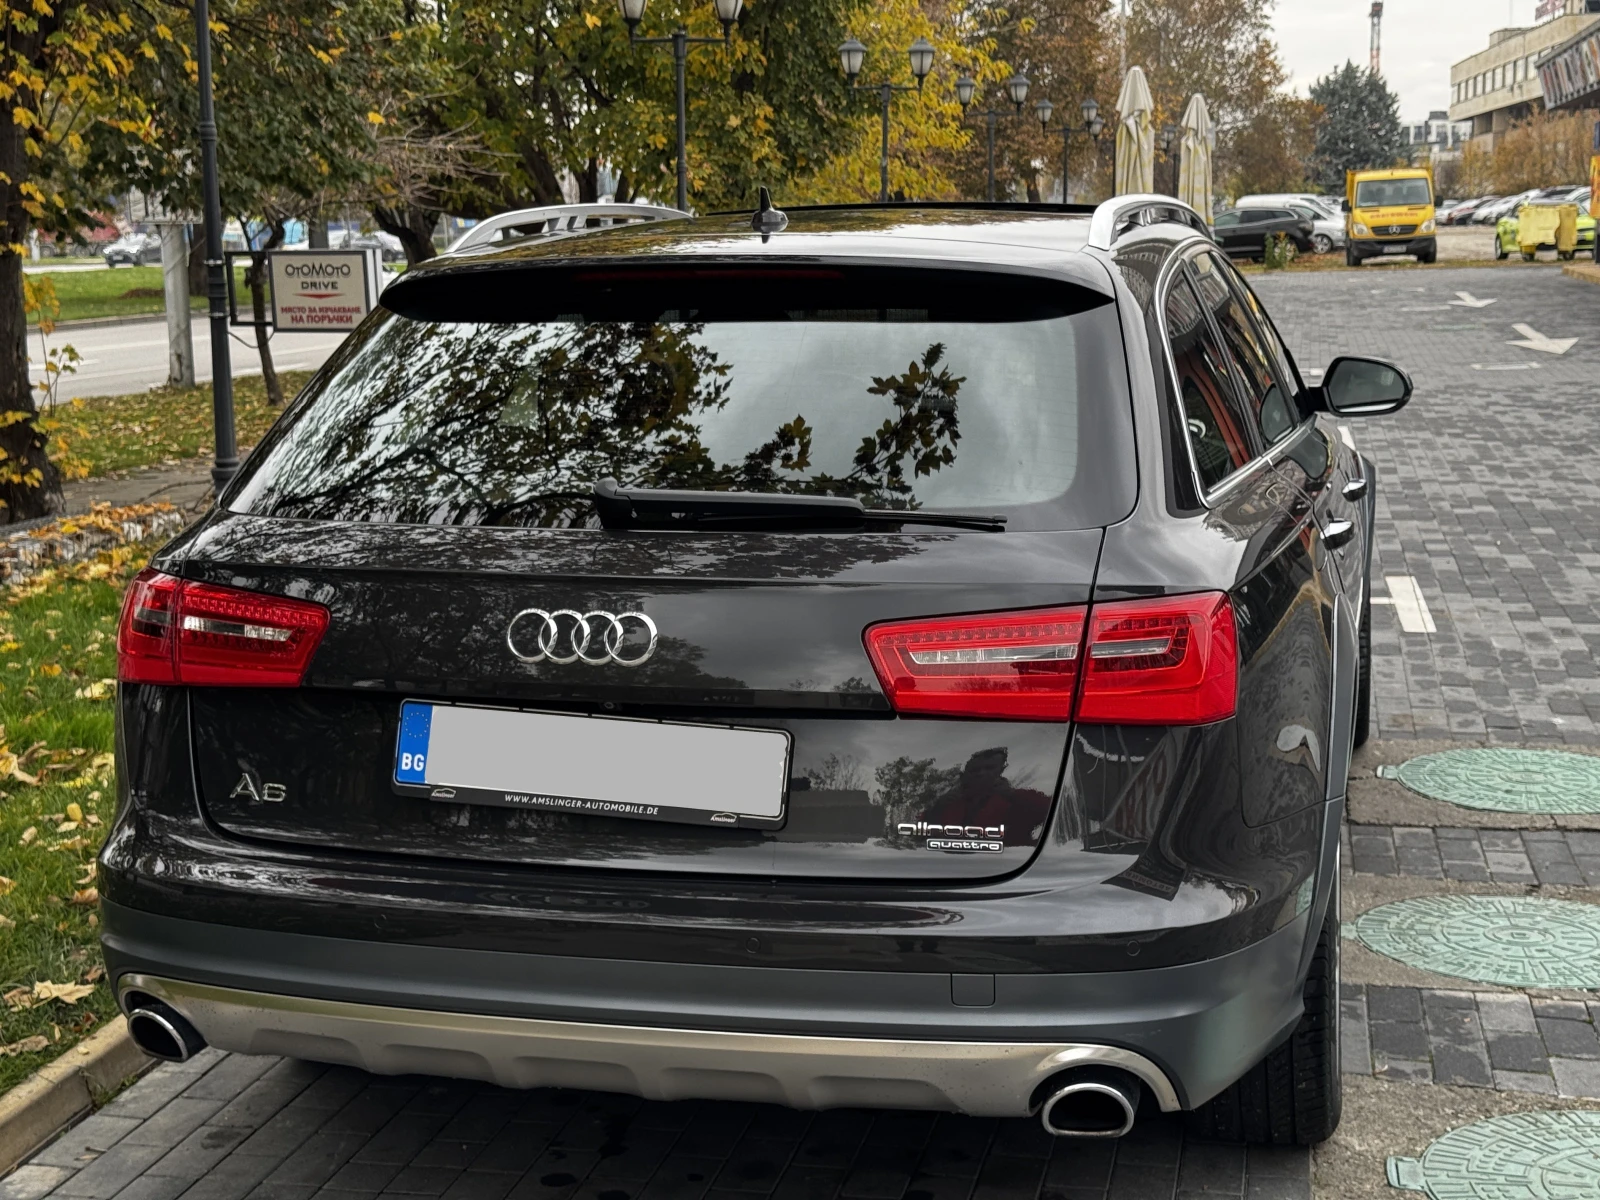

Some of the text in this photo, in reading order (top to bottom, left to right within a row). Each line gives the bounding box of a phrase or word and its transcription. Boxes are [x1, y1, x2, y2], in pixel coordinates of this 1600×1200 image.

[301, 281, 339, 290] DRIVE
[281, 306, 362, 314] МЯСТО ЗА ИЗЧАКВАНЕ
[291, 315, 353, 324] НА ПОРЪЧКИ
[401, 752, 425, 772] BG
[229, 772, 287, 802] A6
[504, 793, 659, 816] WWW.AMSLINGER-AUTOMOBILE.DE
[898, 821, 1005, 839] allroad
[929, 841, 1001, 851] quattro
